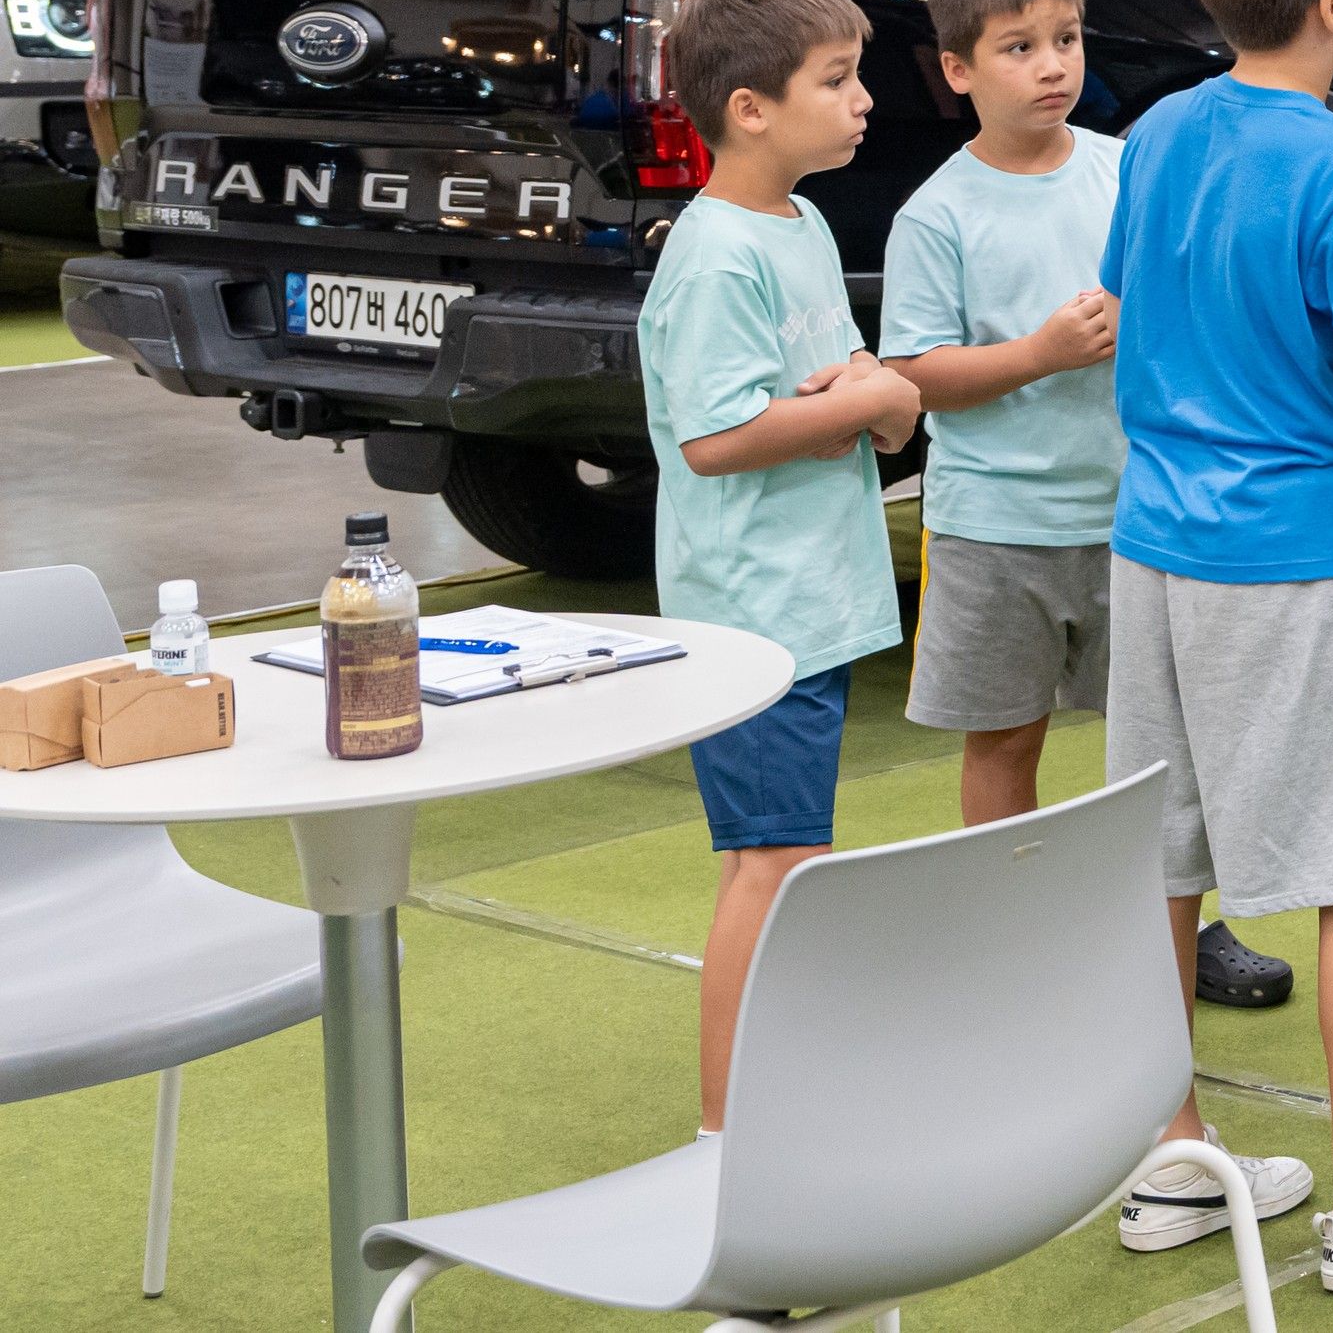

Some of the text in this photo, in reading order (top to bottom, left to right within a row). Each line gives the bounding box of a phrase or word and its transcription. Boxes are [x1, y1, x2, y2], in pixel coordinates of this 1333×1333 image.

[296, 23, 343, 58] Ford
[156, 159, 573, 219] RANGER
[310, 282, 447, 339] 807버 460
[1121, 1206, 1142, 1222] NIKE
